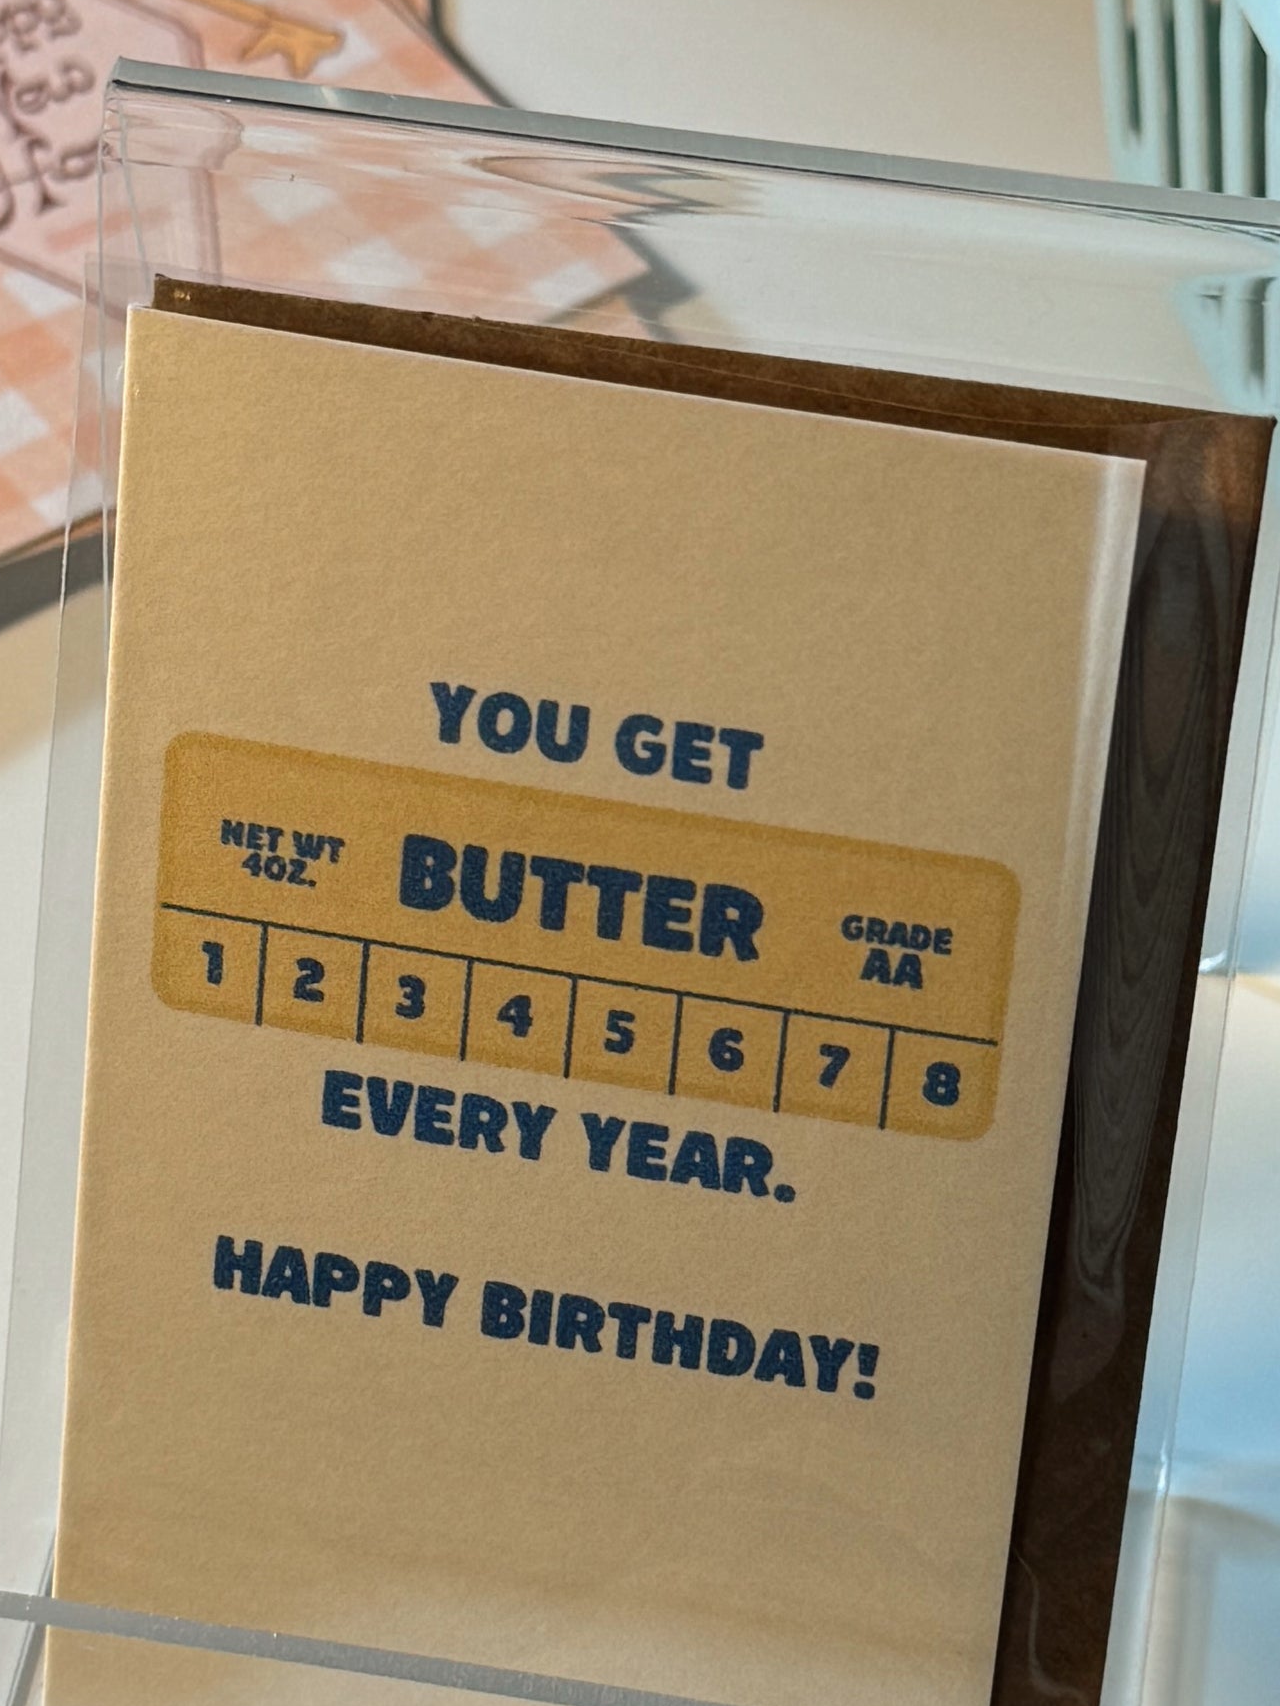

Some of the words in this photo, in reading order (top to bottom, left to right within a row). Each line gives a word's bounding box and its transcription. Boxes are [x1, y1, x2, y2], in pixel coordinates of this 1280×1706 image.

[429, 682, 590, 765] YOU
[613, 713, 765, 792] GET
[221, 819, 284, 852] NET
[292, 830, 345, 864] WT
[398, 834, 764, 962] BUTTER
[840, 914, 954, 956] GRADE
[859, 948, 924, 990] AA
[201, 940, 225, 985] 1
[293, 957, 325, 1003] 2
[395, 975, 426, 1020] 3
[497, 994, 533, 1038] 4
[604, 1010, 636, 1056] 5
[708, 1027, 745, 1072] 6
[819, 1043, 851, 1089] 7
[922, 1061, 961, 1107] 8
[320, 1069, 556, 1162] EVERY
[579, 1112, 796, 1204] YEAR.
[212, 1236, 458, 1329] HAPPY
[479, 1280, 880, 1402] BIRTHDAY!
